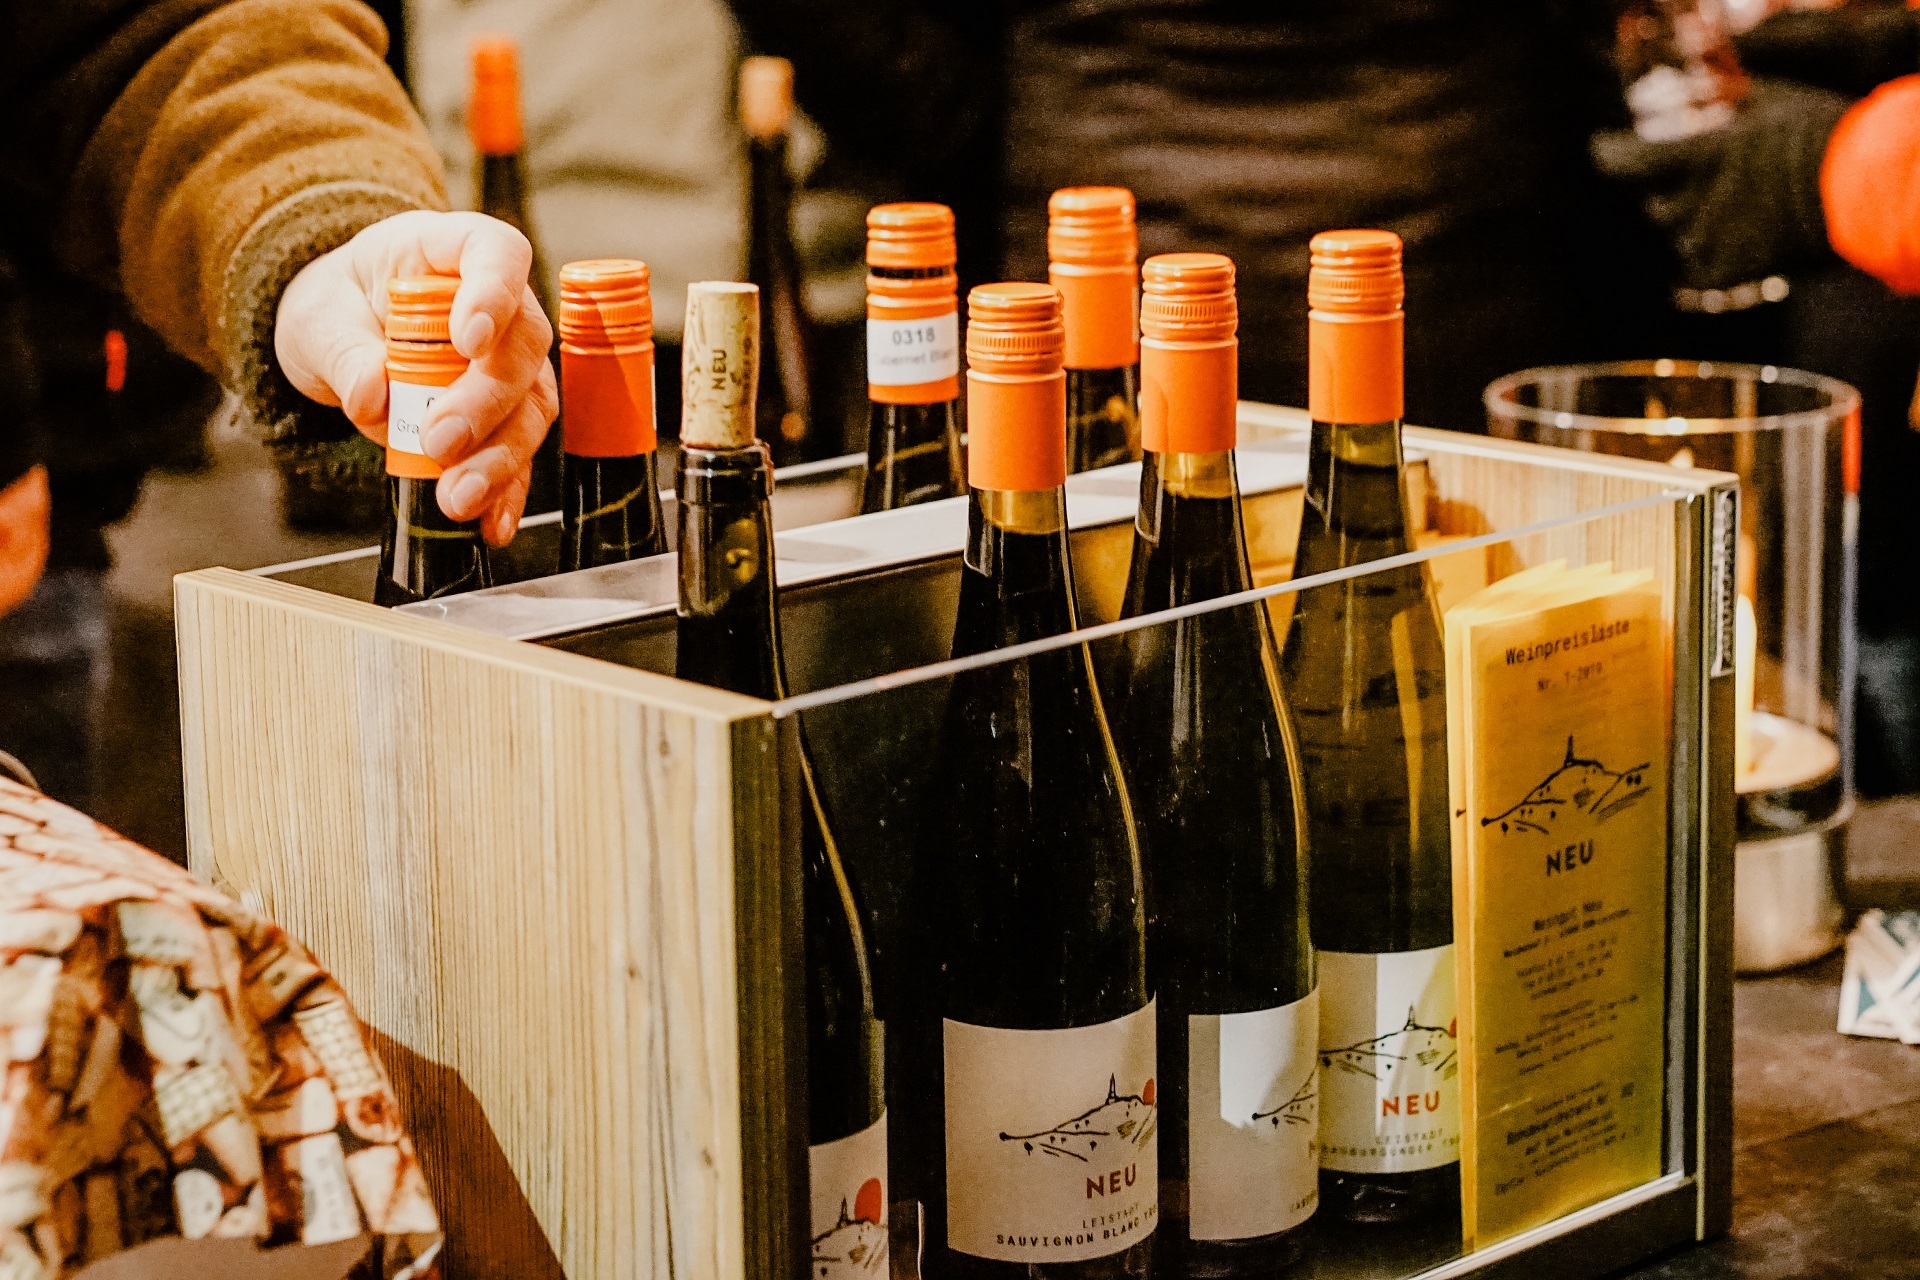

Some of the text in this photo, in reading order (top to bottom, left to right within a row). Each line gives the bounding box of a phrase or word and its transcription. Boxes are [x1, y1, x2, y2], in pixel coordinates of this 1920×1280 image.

[892, 327, 935, 346] 0318
[711, 349, 728, 391] NEU
[1505, 619, 1630, 666] Weinpreisliste
[1546, 839, 1594, 876] NEU
[1382, 1090, 1441, 1117] NEU
[1086, 1163, 1137, 1199] NEU
[996, 1233, 1094, 1248] SAUVIGNON
[1103, 1216, 1139, 1240] BLANC
